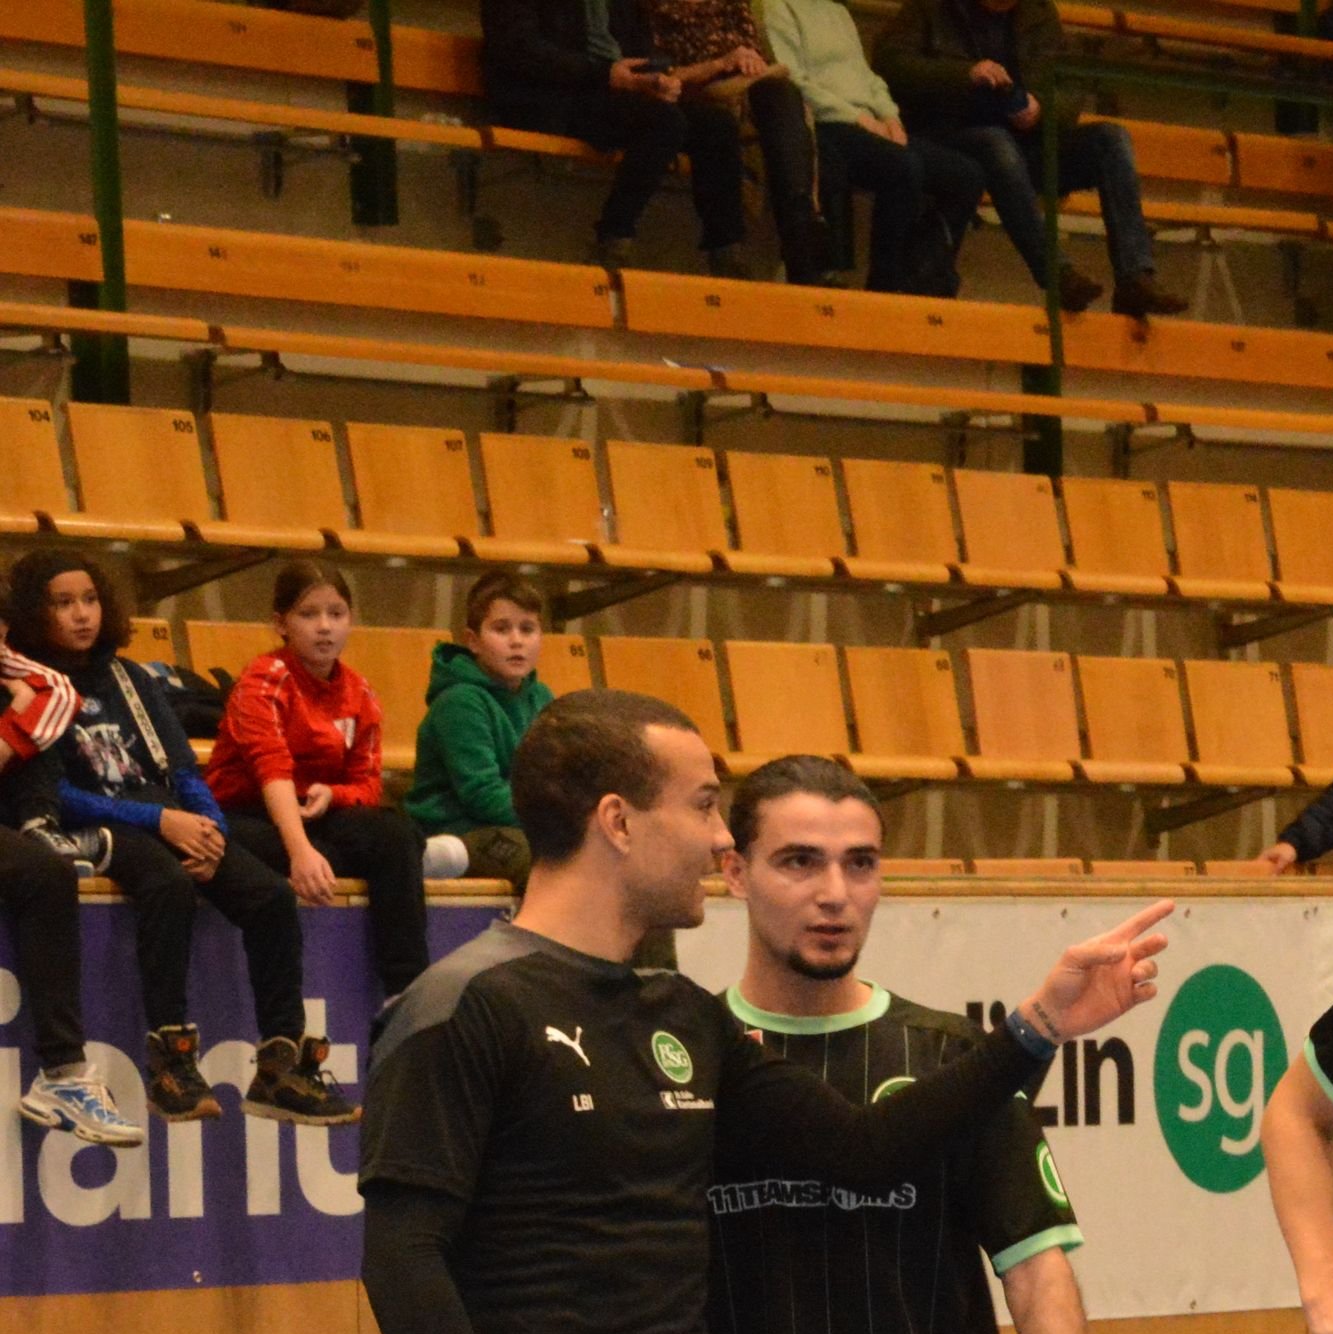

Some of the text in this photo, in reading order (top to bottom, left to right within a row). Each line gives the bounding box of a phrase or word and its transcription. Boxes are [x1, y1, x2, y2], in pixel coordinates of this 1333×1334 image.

[28, 410, 50, 423] 104
[172, 419, 193, 433] 105
[311, 429, 331, 442] 106
[152, 627, 168, 640] 62
[1177, 1028, 1265, 1155] sg
